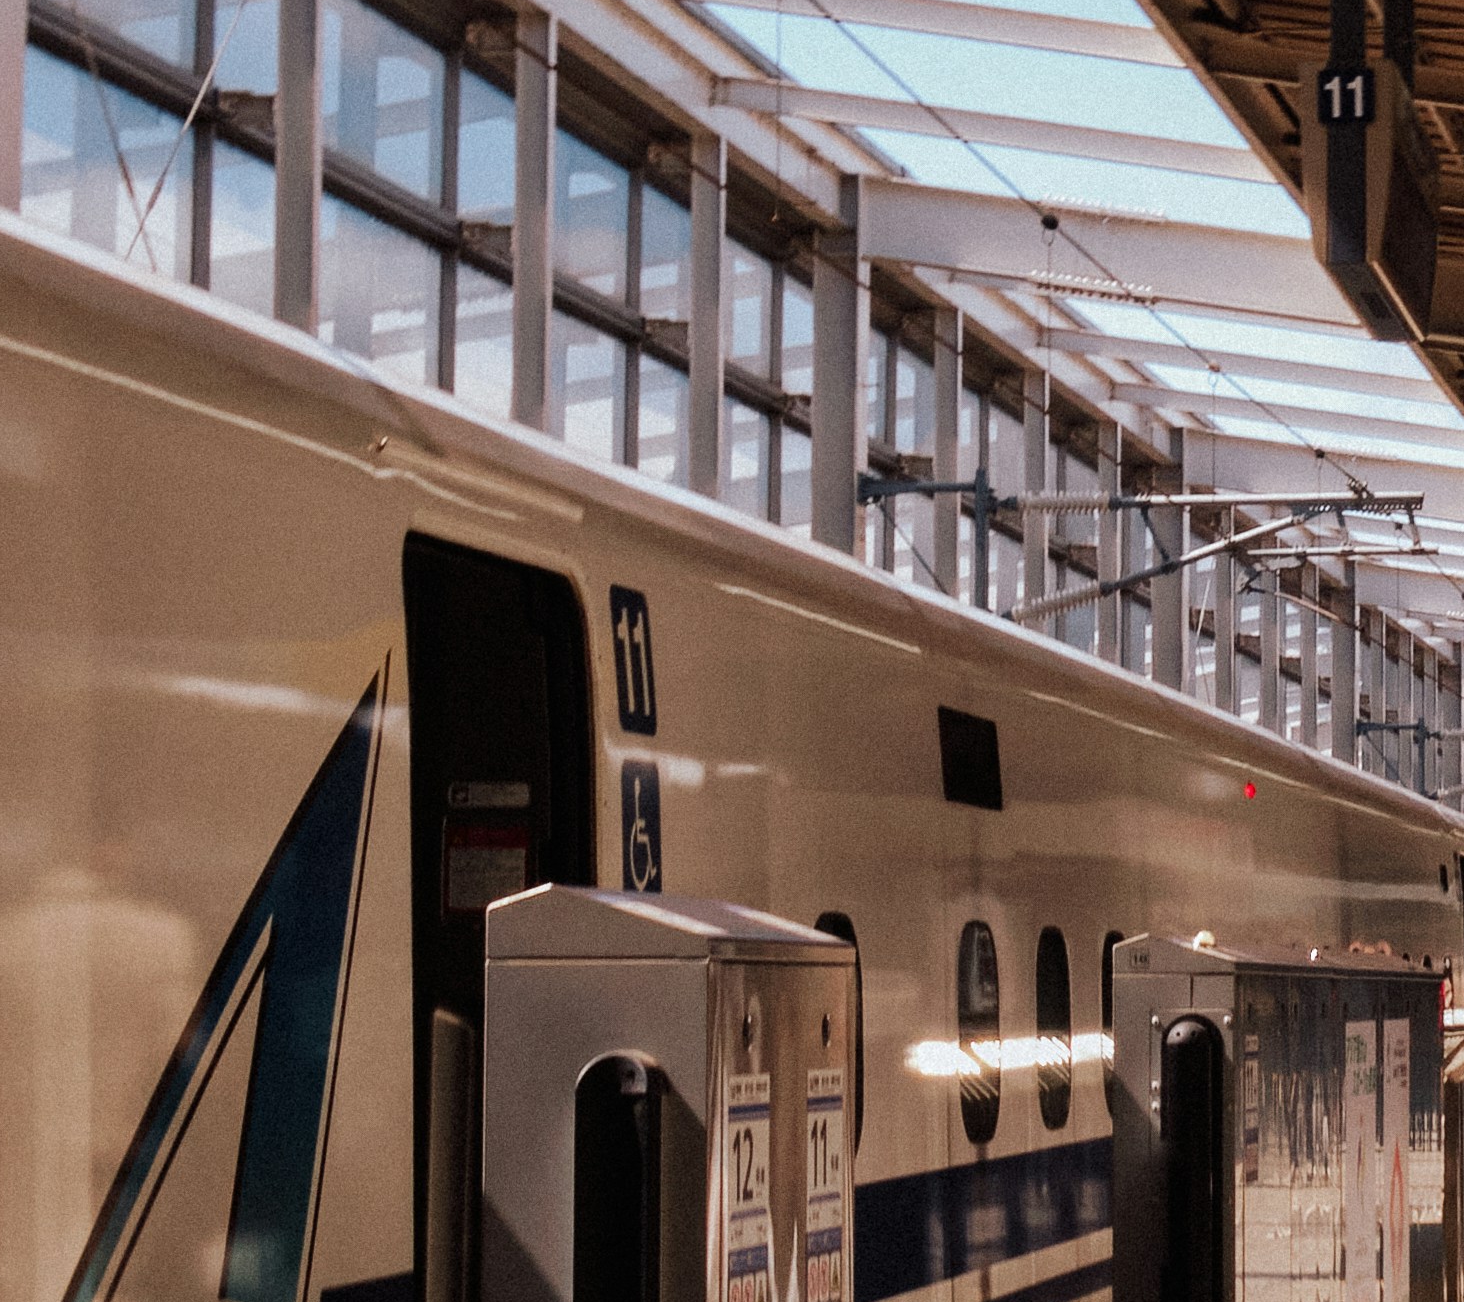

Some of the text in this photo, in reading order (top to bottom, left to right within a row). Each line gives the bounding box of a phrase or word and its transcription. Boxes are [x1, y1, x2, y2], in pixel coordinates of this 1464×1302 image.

[1323, 74, 1365, 119] 11
[617, 606, 651, 718] 11
[733, 1127, 754, 1204] 12
[810, 1117, 827, 1188] 11
